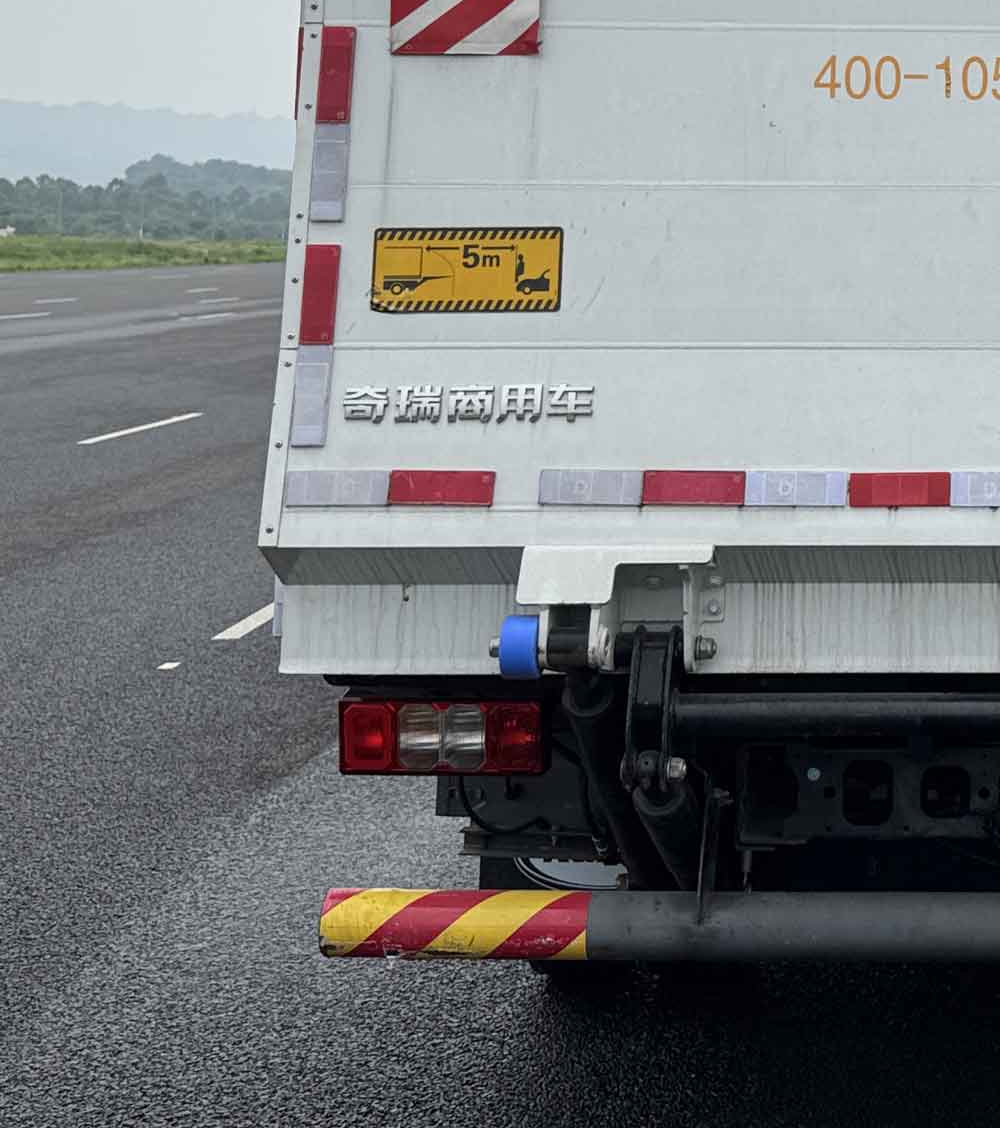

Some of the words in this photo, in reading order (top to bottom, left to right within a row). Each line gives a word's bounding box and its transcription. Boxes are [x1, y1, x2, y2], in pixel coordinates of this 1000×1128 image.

[462, 244, 501, 269] 5m
[343, 383, 595, 424] 奇瑞商用车
